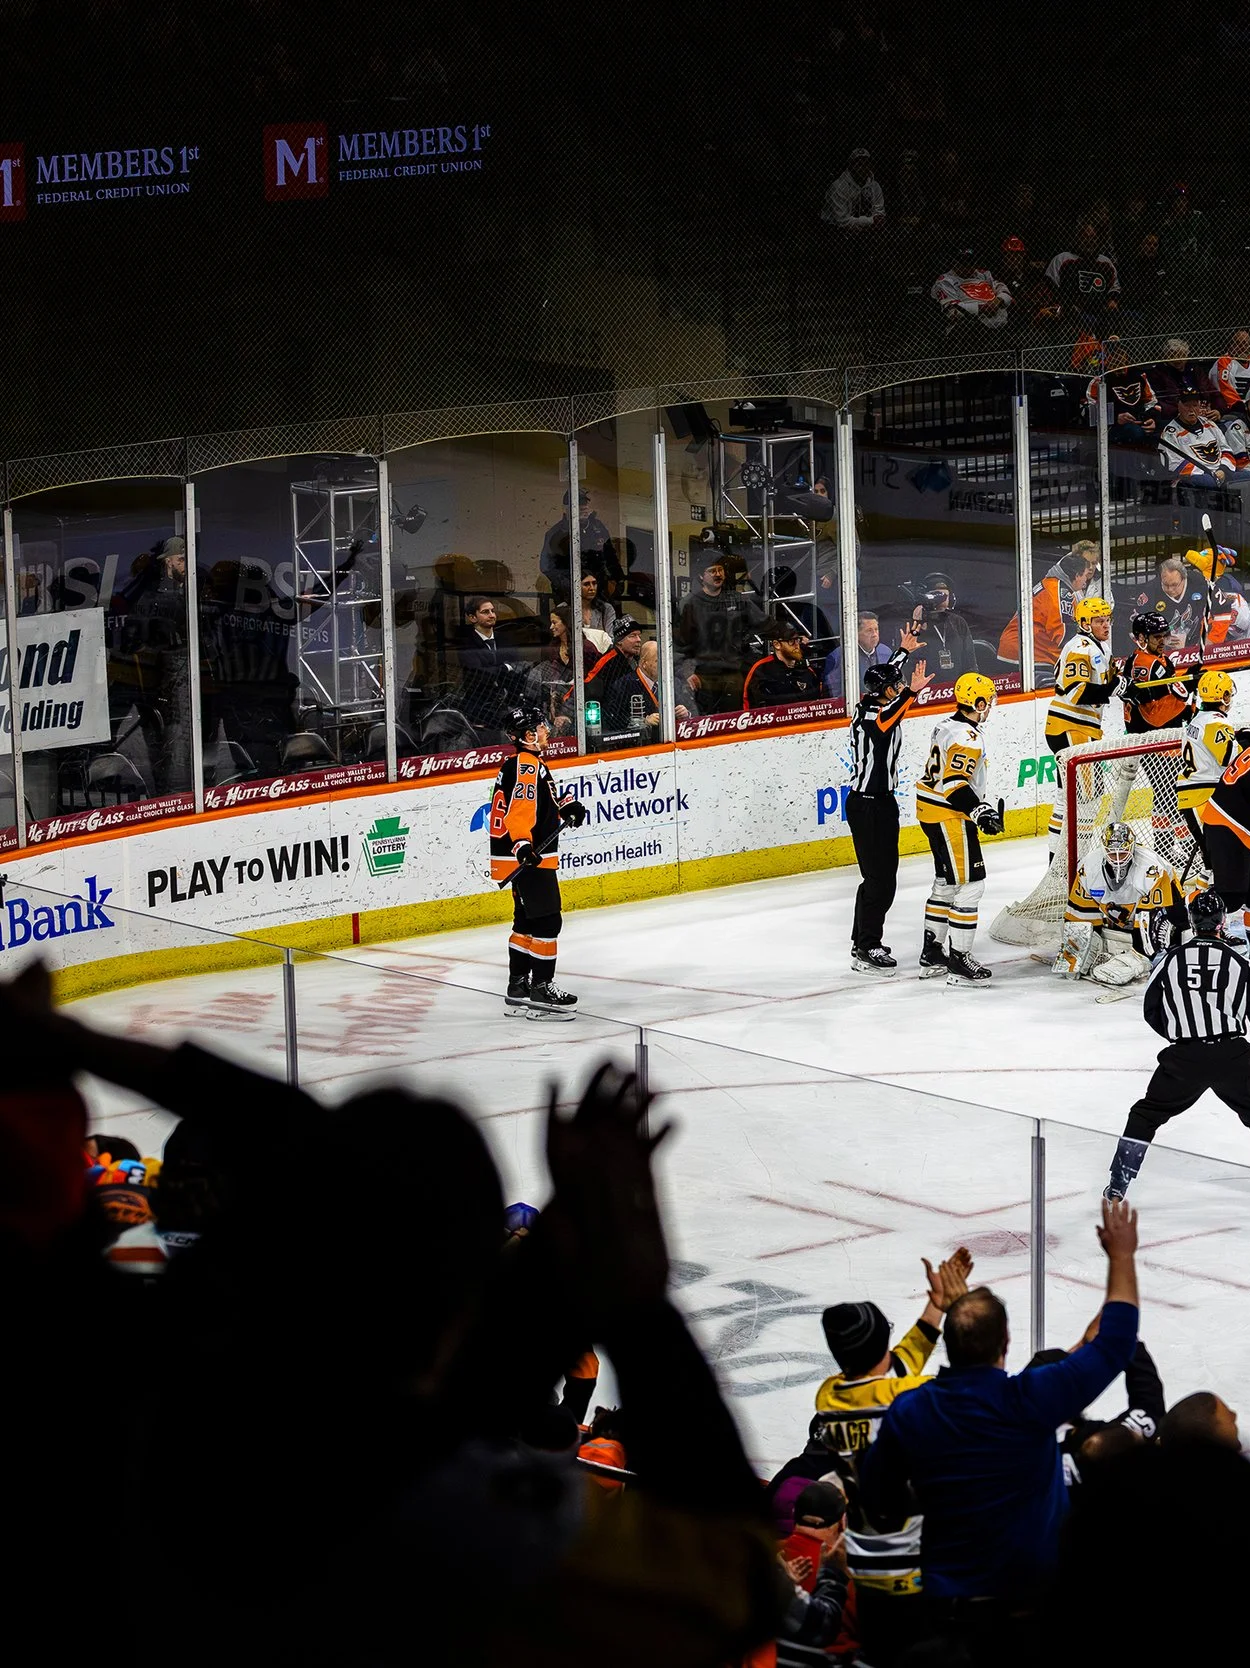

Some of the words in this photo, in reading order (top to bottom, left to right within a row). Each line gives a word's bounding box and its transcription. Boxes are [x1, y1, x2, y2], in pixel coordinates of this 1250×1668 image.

[338, 125, 467, 162] MEMBERS
[471, 123, 492, 152] 1st
[36, 147, 175, 185] MEMBERS
[179, 145, 200, 174] 1st
[339, 167, 392, 181] FEDERAL
[394, 164, 439, 177] CREDIT
[441, 160, 483, 173] UNION
[37, 190, 93, 204] FEDERAL
[96, 187, 143, 200] CREDIT
[146, 183, 190, 198] UNION
[223, 614, 280, 635] CORPORATE
[282, 625, 329, 643] BEEFITS
[1220, 651, 1237, 659] CHOICE
[917, 686, 954, 704] GLASS
[788, 706, 807, 714] LEHIGH
[809, 703, 832, 711] VALLEY'S
[827, 707, 844, 715] GLASS
[736, 712, 774, 730] GLASS
[463, 751, 502, 769] GLASS
[559, 747, 577, 755] GLASS
[324, 772, 345, 780] LEHIGH
[347, 767, 372, 777] VALLEY'S
[950, 753, 977, 776] 52
[269, 779, 310, 798] GLASS
[311, 781, 329, 789] CLEAR
[330, 778, 352, 786] CHOICE
[367, 772, 385, 780] GLASS
[600, 768, 661, 795] Valley
[514, 782, 536, 800] 26
[126, 813, 142, 821] CLEAR
[143, 809, 163, 818] CHOICE
[165, 806, 175, 814] FOR
[177, 803, 194, 812] GLASS
[137, 803, 157, 812] LEHIGH
[159, 798, 182, 808] VALLEY'S
[596, 788, 690, 824] Network
[86, 811, 125, 831] GLASS
[372, 837, 406, 846] PENNSYLVANIA
[372, 842, 406, 855] LOTTERY
[615, 840, 662, 861] Health
[147, 856, 231, 908] PLAY
[234, 858, 264, 885] TO
[267, 835, 350, 883] WIN!
[1187, 964, 1220, 990] 57
